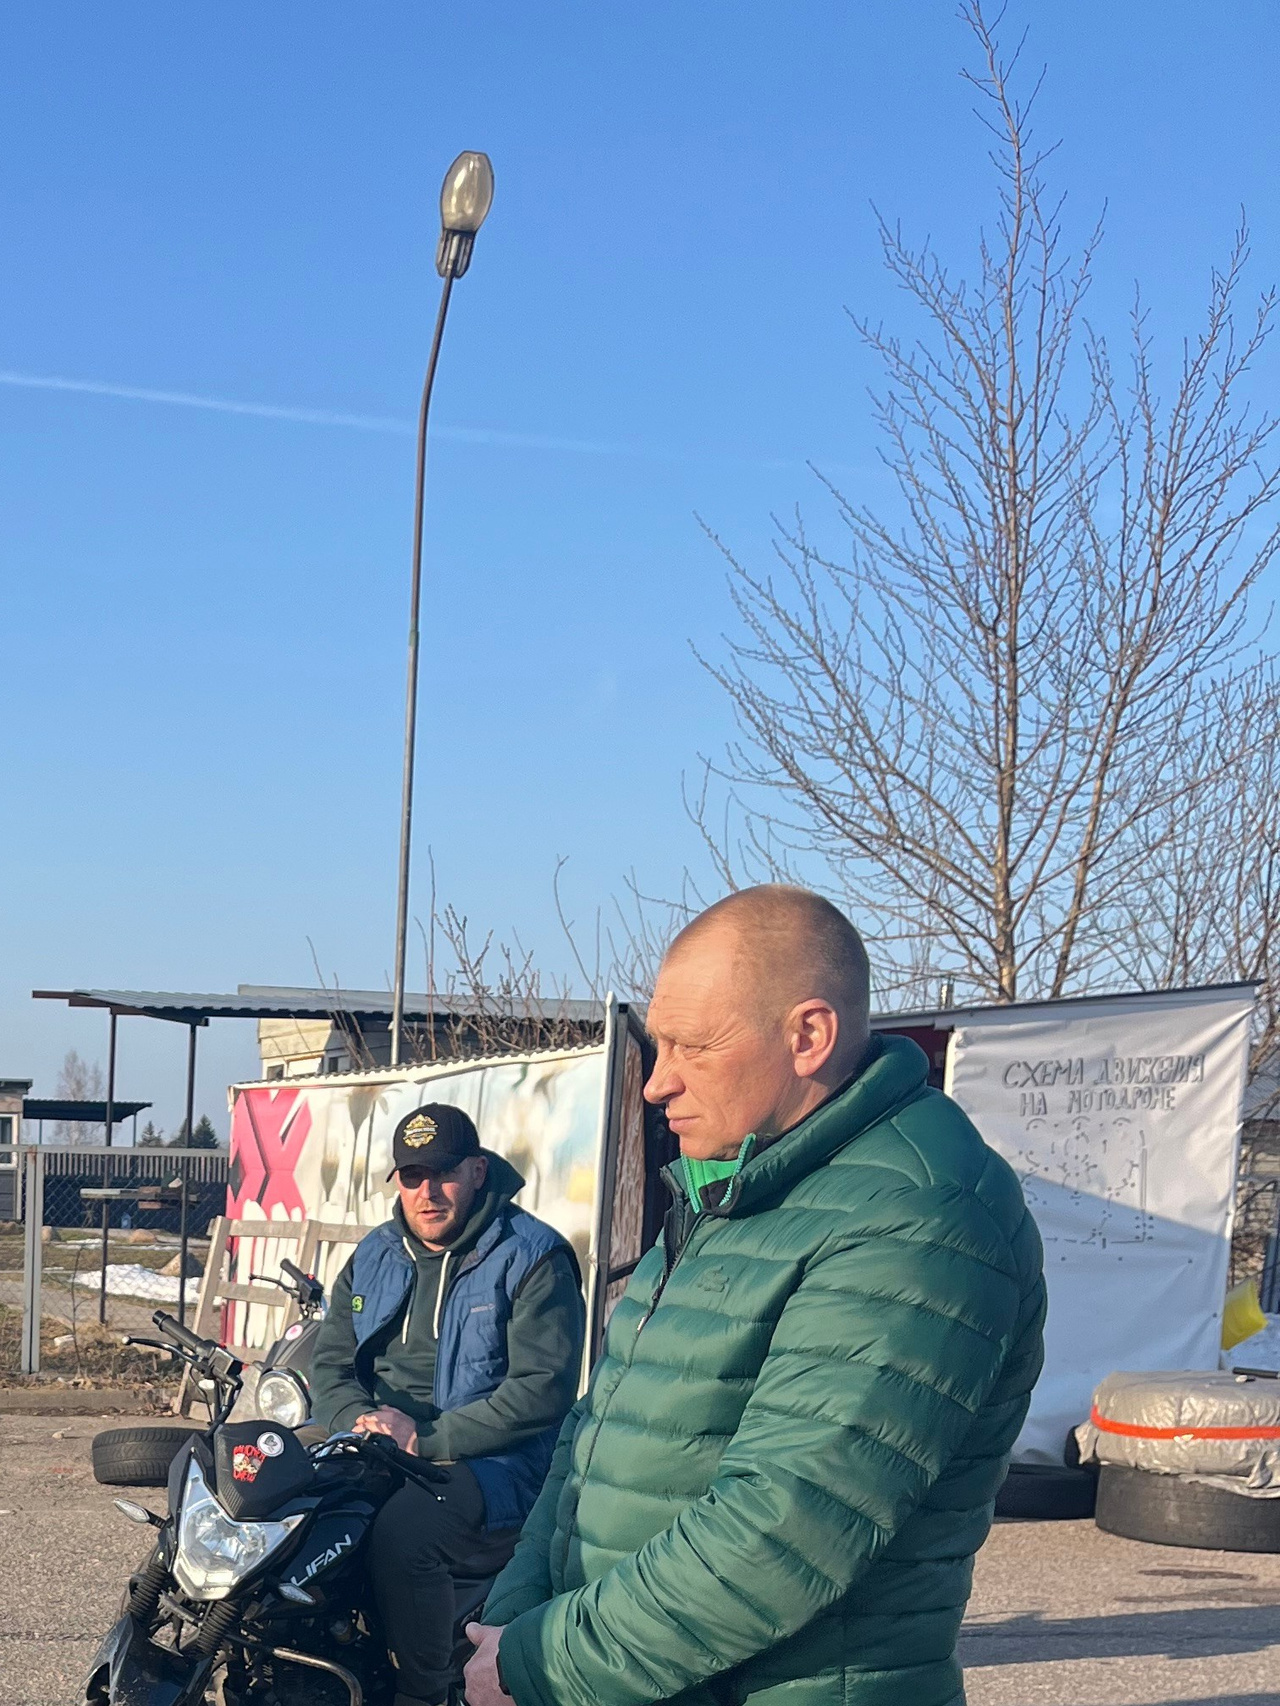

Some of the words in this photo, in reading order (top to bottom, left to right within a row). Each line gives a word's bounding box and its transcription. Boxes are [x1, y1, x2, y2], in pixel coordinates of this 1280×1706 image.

[1002, 1057, 1084, 1089] СХЕМА
[1020, 1091, 1048, 1116] НА
[290, 1533, 352, 1587] LIFAN
